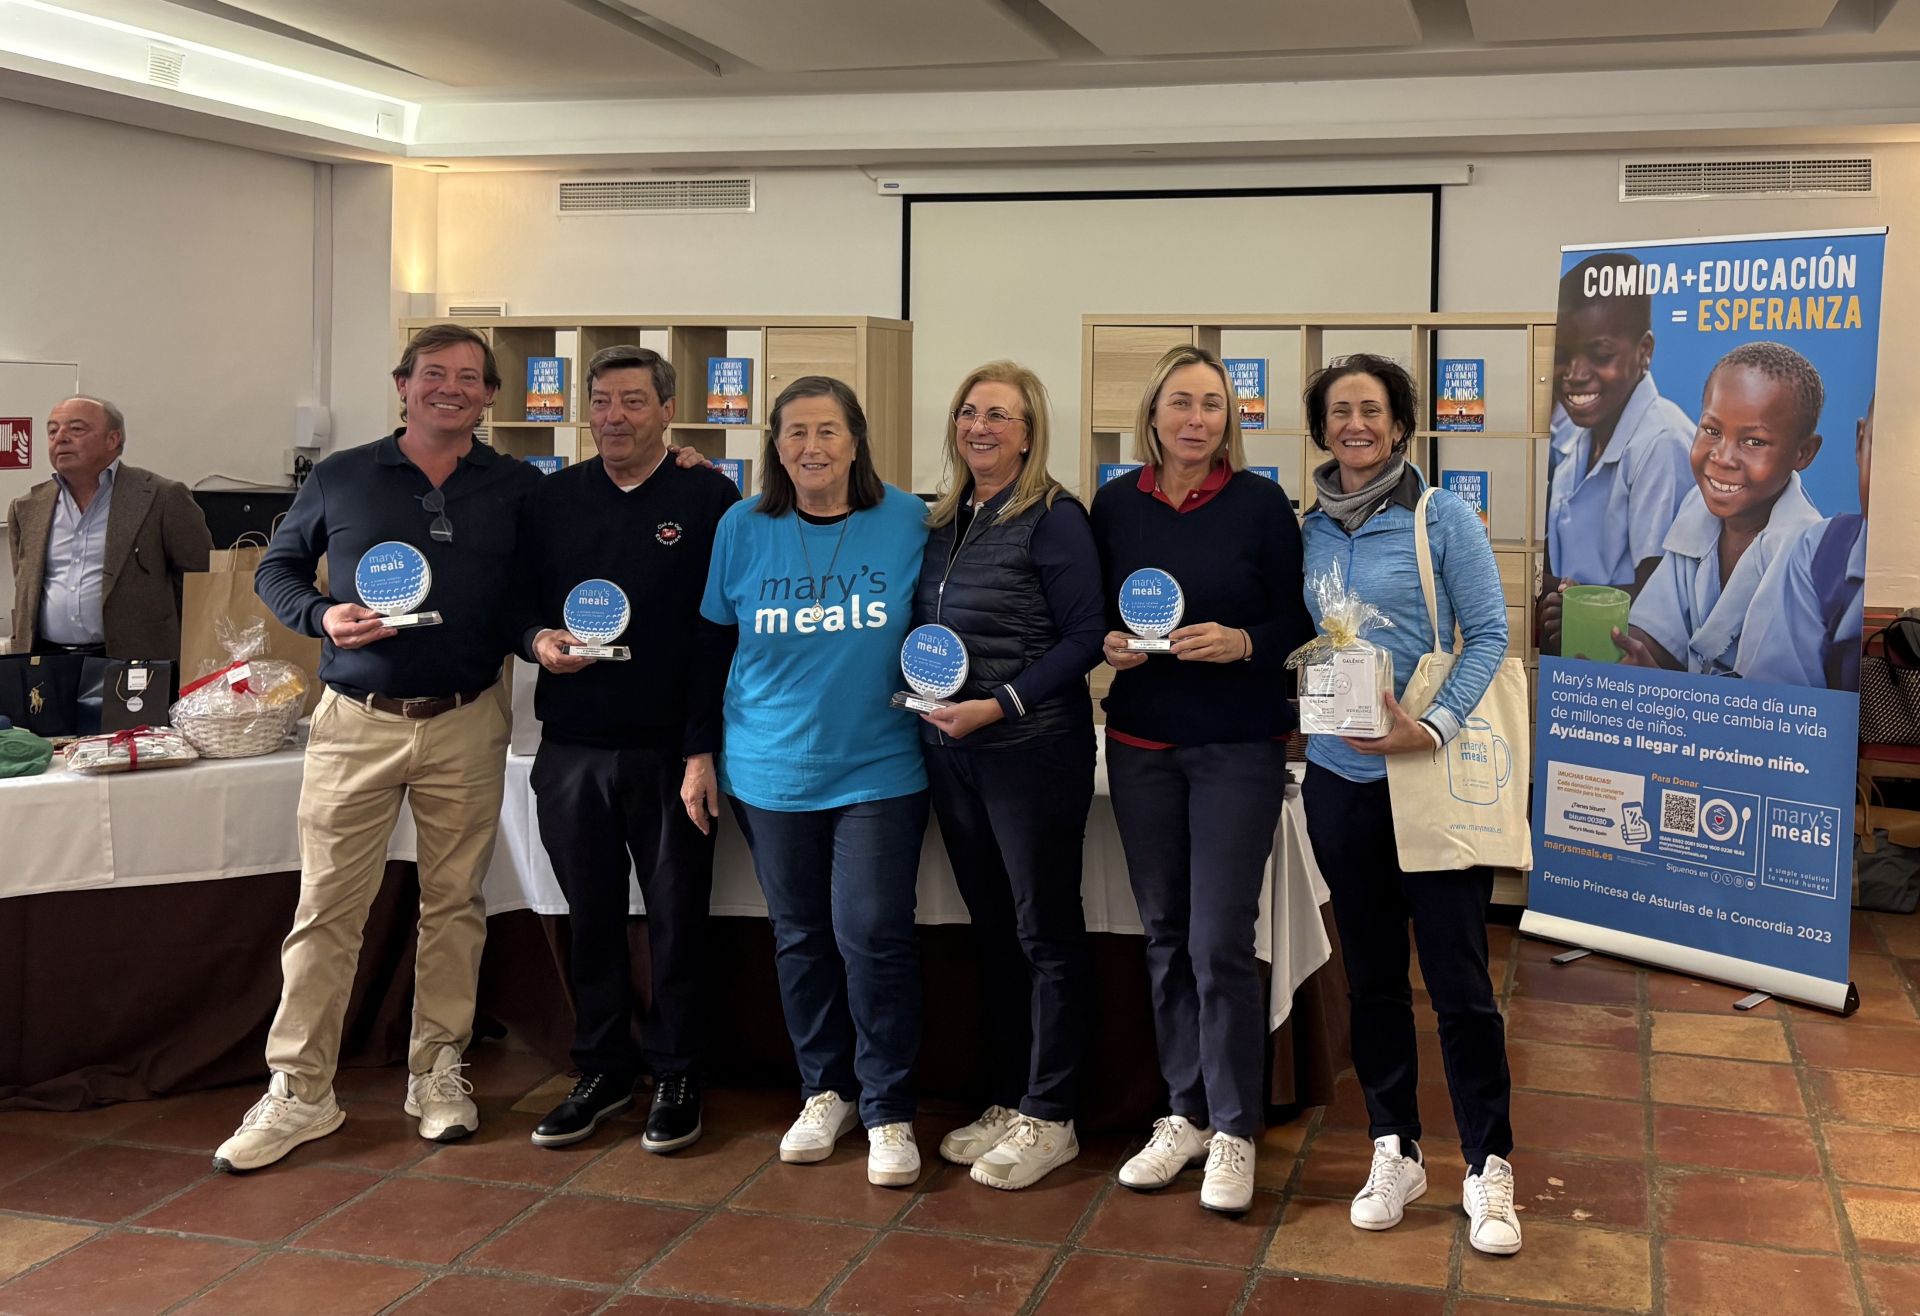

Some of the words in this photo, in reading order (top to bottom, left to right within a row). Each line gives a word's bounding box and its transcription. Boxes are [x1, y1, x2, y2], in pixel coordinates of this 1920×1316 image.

[1698, 296, 1862, 332] ESPERANZA
[1444, 388, 1453, 400] DE
[369, 550, 404, 564] mary's
[370, 560, 404, 573] meals
[760, 564, 887, 603] mary's
[1132, 577, 1161, 587] mary's
[580, 588, 610, 597] mary's
[1132, 586, 1161, 595] meals
[579, 596, 609, 606] meals
[755, 594, 888, 634] meals
[918, 632, 949, 647] mary's
[917, 641, 948, 656] meals
[1553, 670, 1593, 689] Mary's
[1597, 676, 1634, 693] Meals
[1638, 684, 1720, 705] proporciona
[1724, 696, 1758, 710] cada
[1762, 698, 1784, 713] día
[1789, 704, 1816, 717] una
[1551, 706, 1567, 719] de
[1571, 710, 1623, 727] millones
[1627, 716, 1644, 730] de
[1648, 721, 1686, 737] niños.
[1552, 690, 1597, 706] comida
[1601, 698, 1617, 709] en
[1621, 698, 1633, 711] el
[1637, 701, 1688, 720] colegio,
[1692, 710, 1719, 724] que
[1723, 714, 1774, 730] cambia
[1779, 719, 1790, 733] la
[1795, 722, 1827, 738] vida
[1460, 742, 1487, 753] mary's
[1550, 722, 1620, 744] Ayúdanos
[1623, 736, 1632, 747] a
[1636, 735, 1678, 754] llegar
[1682, 743, 1695, 757] al
[1700, 747, 1763, 767] próximo
[1768, 756, 1810, 774] niño.
[1461, 752, 1487, 763] meals
[1652, 773, 1671, 784] Para
[1672, 776, 1699, 788] Donar
[1568, 813, 1586, 822] bizum
[1773, 808, 1832, 830] mary's
[1771, 824, 1831, 846] meals
[1544, 840, 1613, 861] marysmeals.es
[1776, 868, 1797, 878] simple
[1801, 873, 1829, 883] solution
[1779, 876, 1798, 885] world
[1803, 881, 1829, 891] hunger
[1544, 871, 1580, 889] Premio
[1583, 880, 1628, 899] Princesa
[1632, 890, 1646, 903] de
[1649, 894, 1695, 915] Asturias
[1698, 905, 1713, 918] de
[1716, 908, 1727, 921] la
[1730, 911, 1793, 936] Concordia
[1797, 926, 1832, 944] 2023
